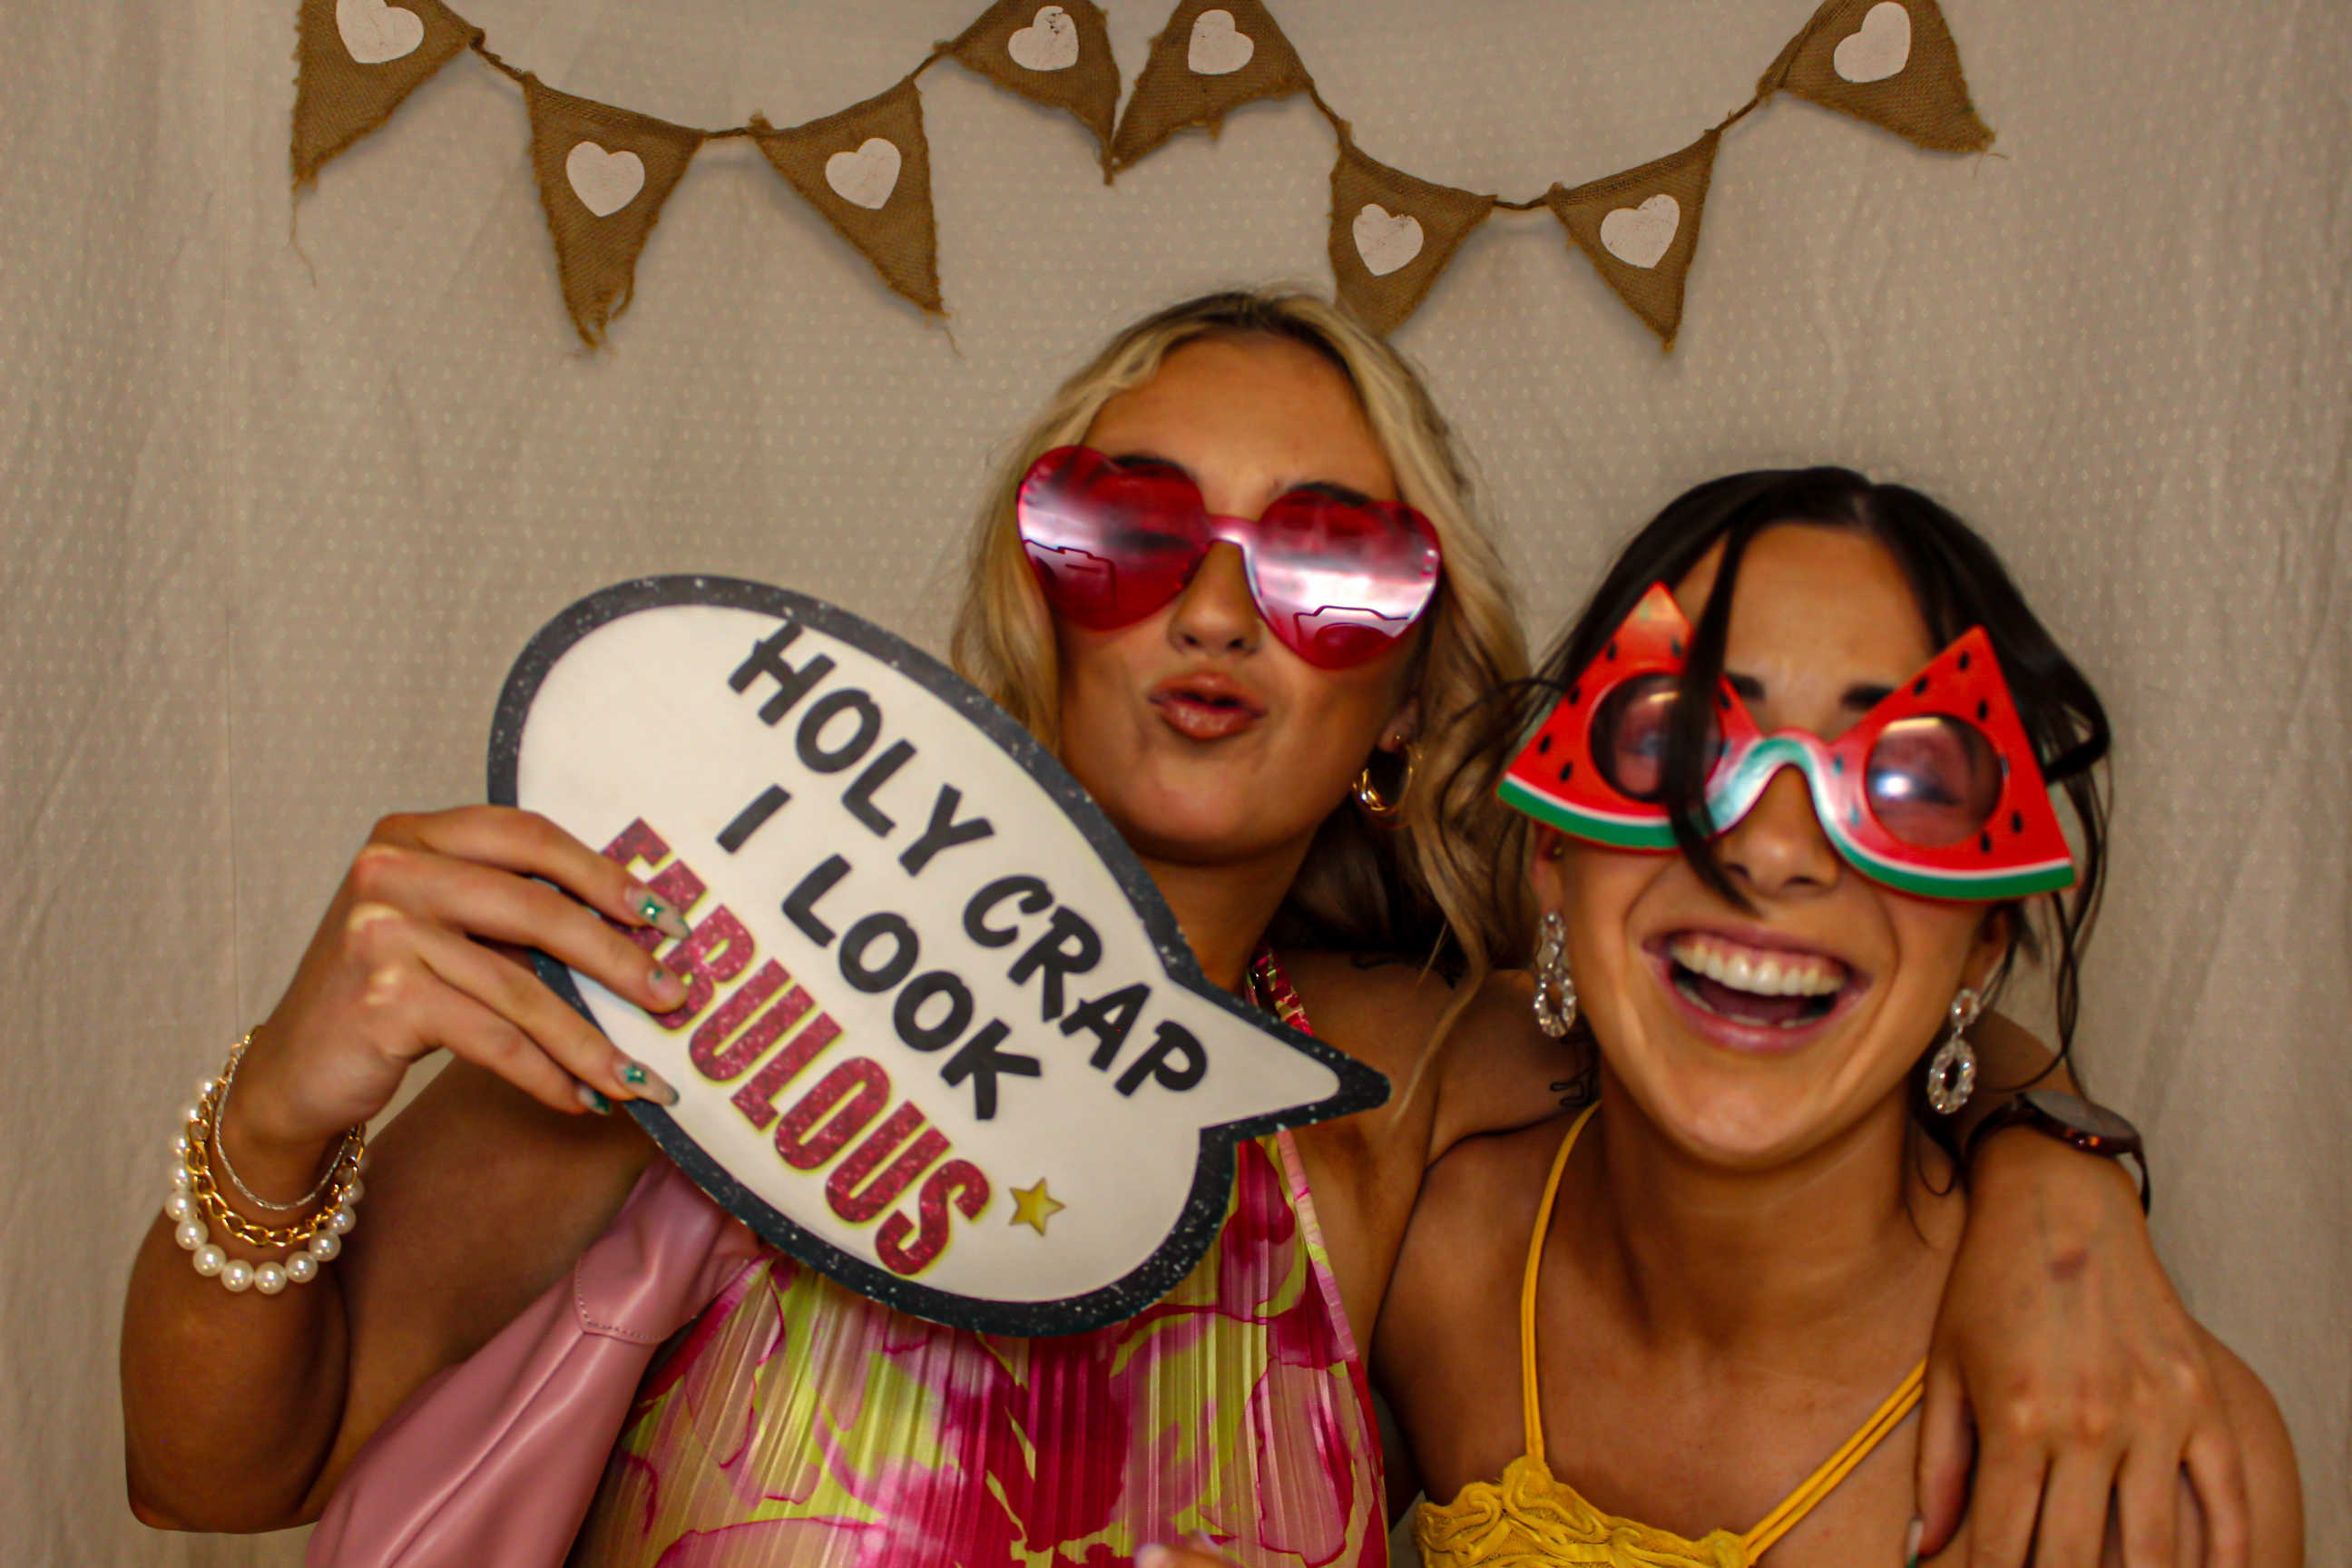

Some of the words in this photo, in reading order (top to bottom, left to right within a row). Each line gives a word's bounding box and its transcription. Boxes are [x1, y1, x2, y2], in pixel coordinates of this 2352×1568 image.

[716, 784, 792, 855] I
[780, 854, 1042, 1121] LOOK
[728, 622, 994, 877] HOLY
[963, 875, 1208, 1097] CRAP
